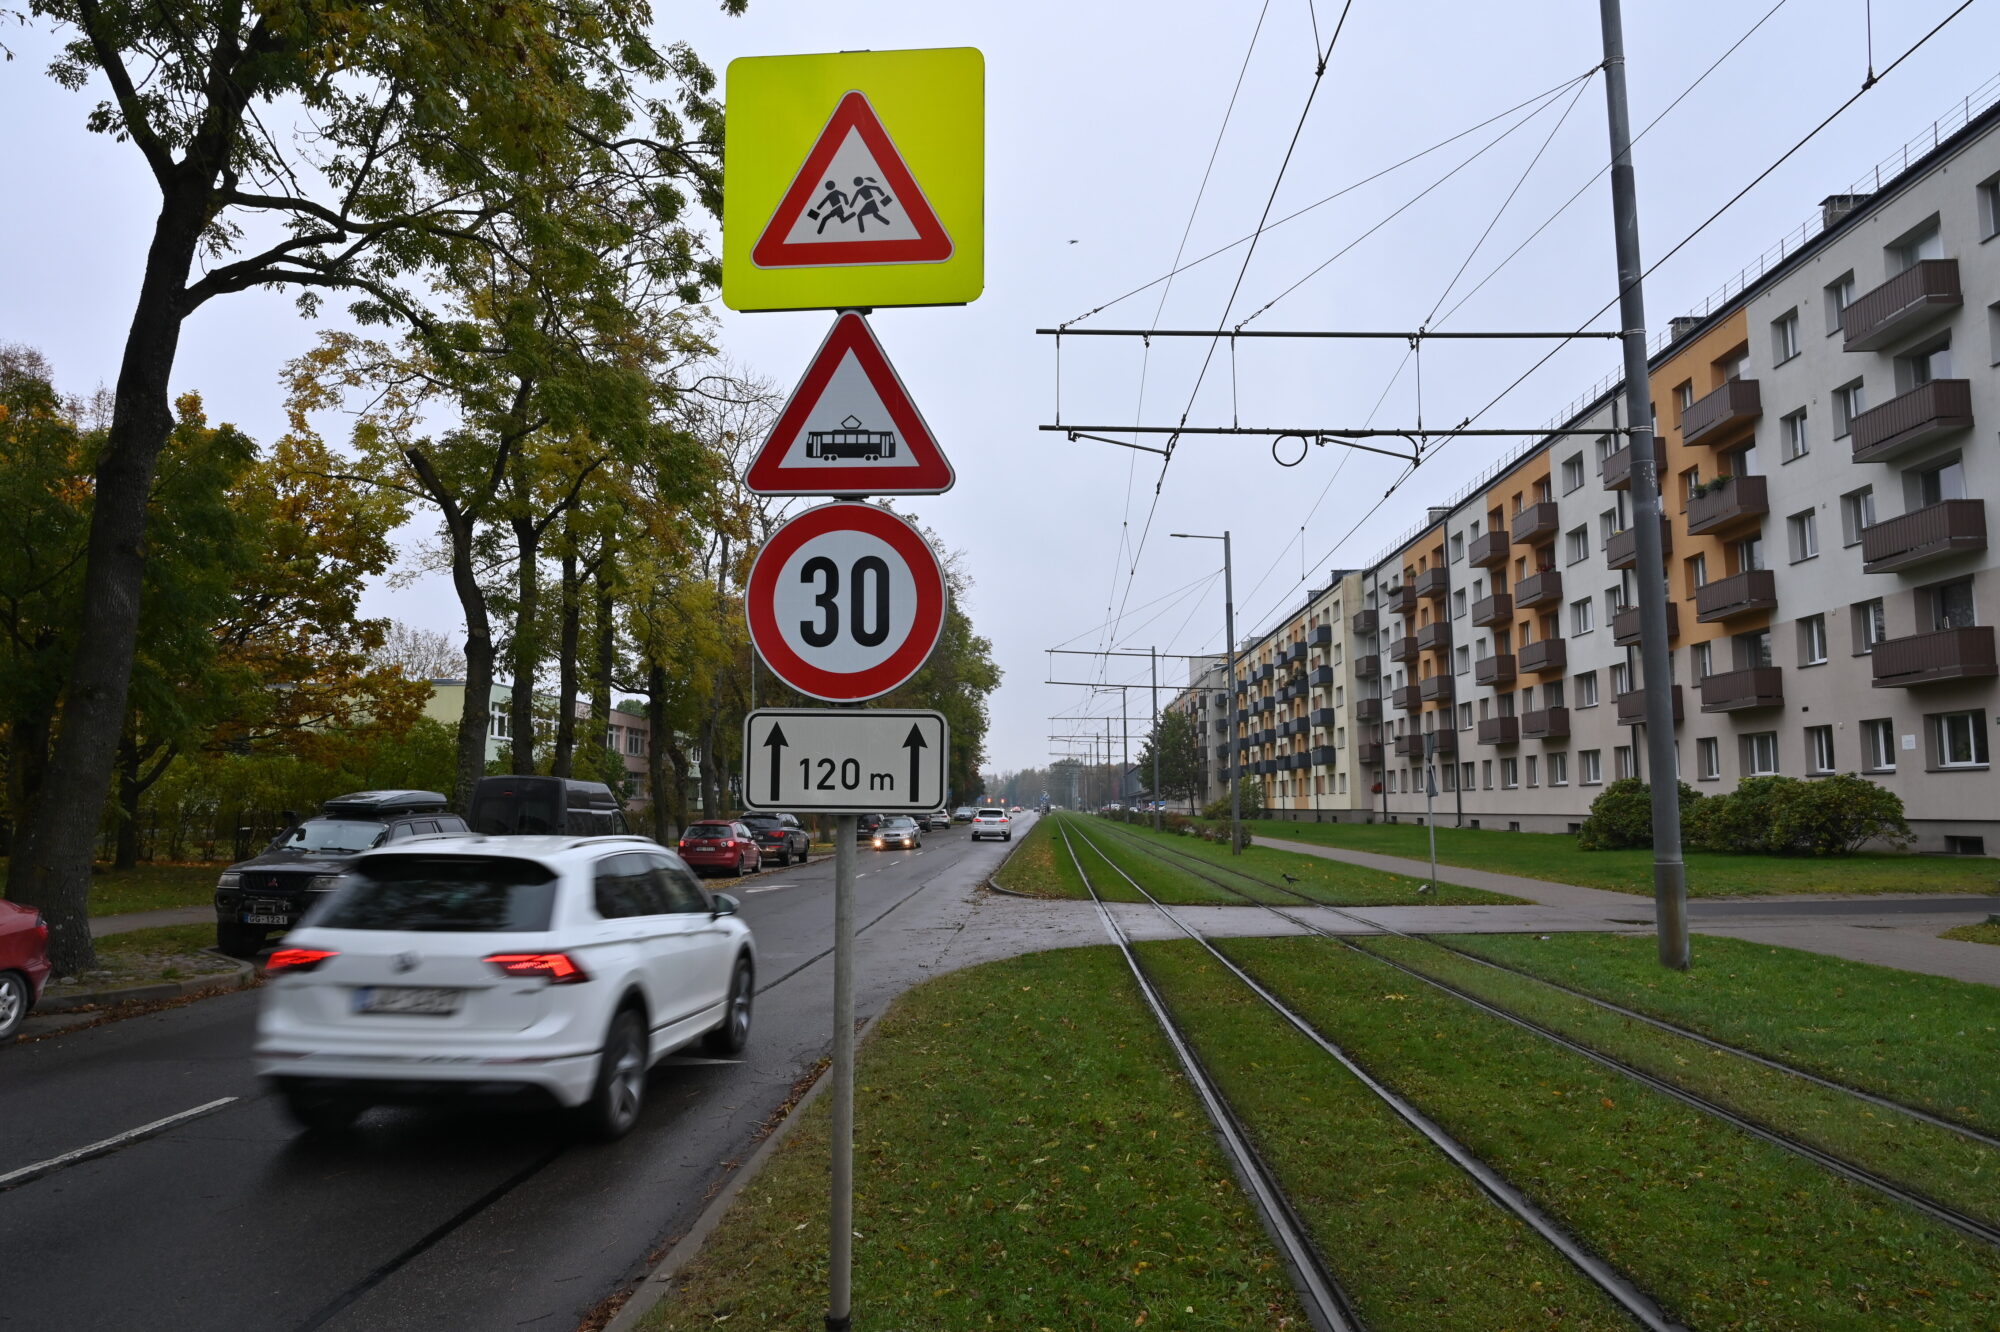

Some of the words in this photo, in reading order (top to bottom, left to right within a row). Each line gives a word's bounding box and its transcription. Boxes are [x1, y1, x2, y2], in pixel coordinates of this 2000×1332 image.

[800, 555, 890, 647] 30
[799, 758, 860, 790] 120
[870, 772, 894, 790] m
